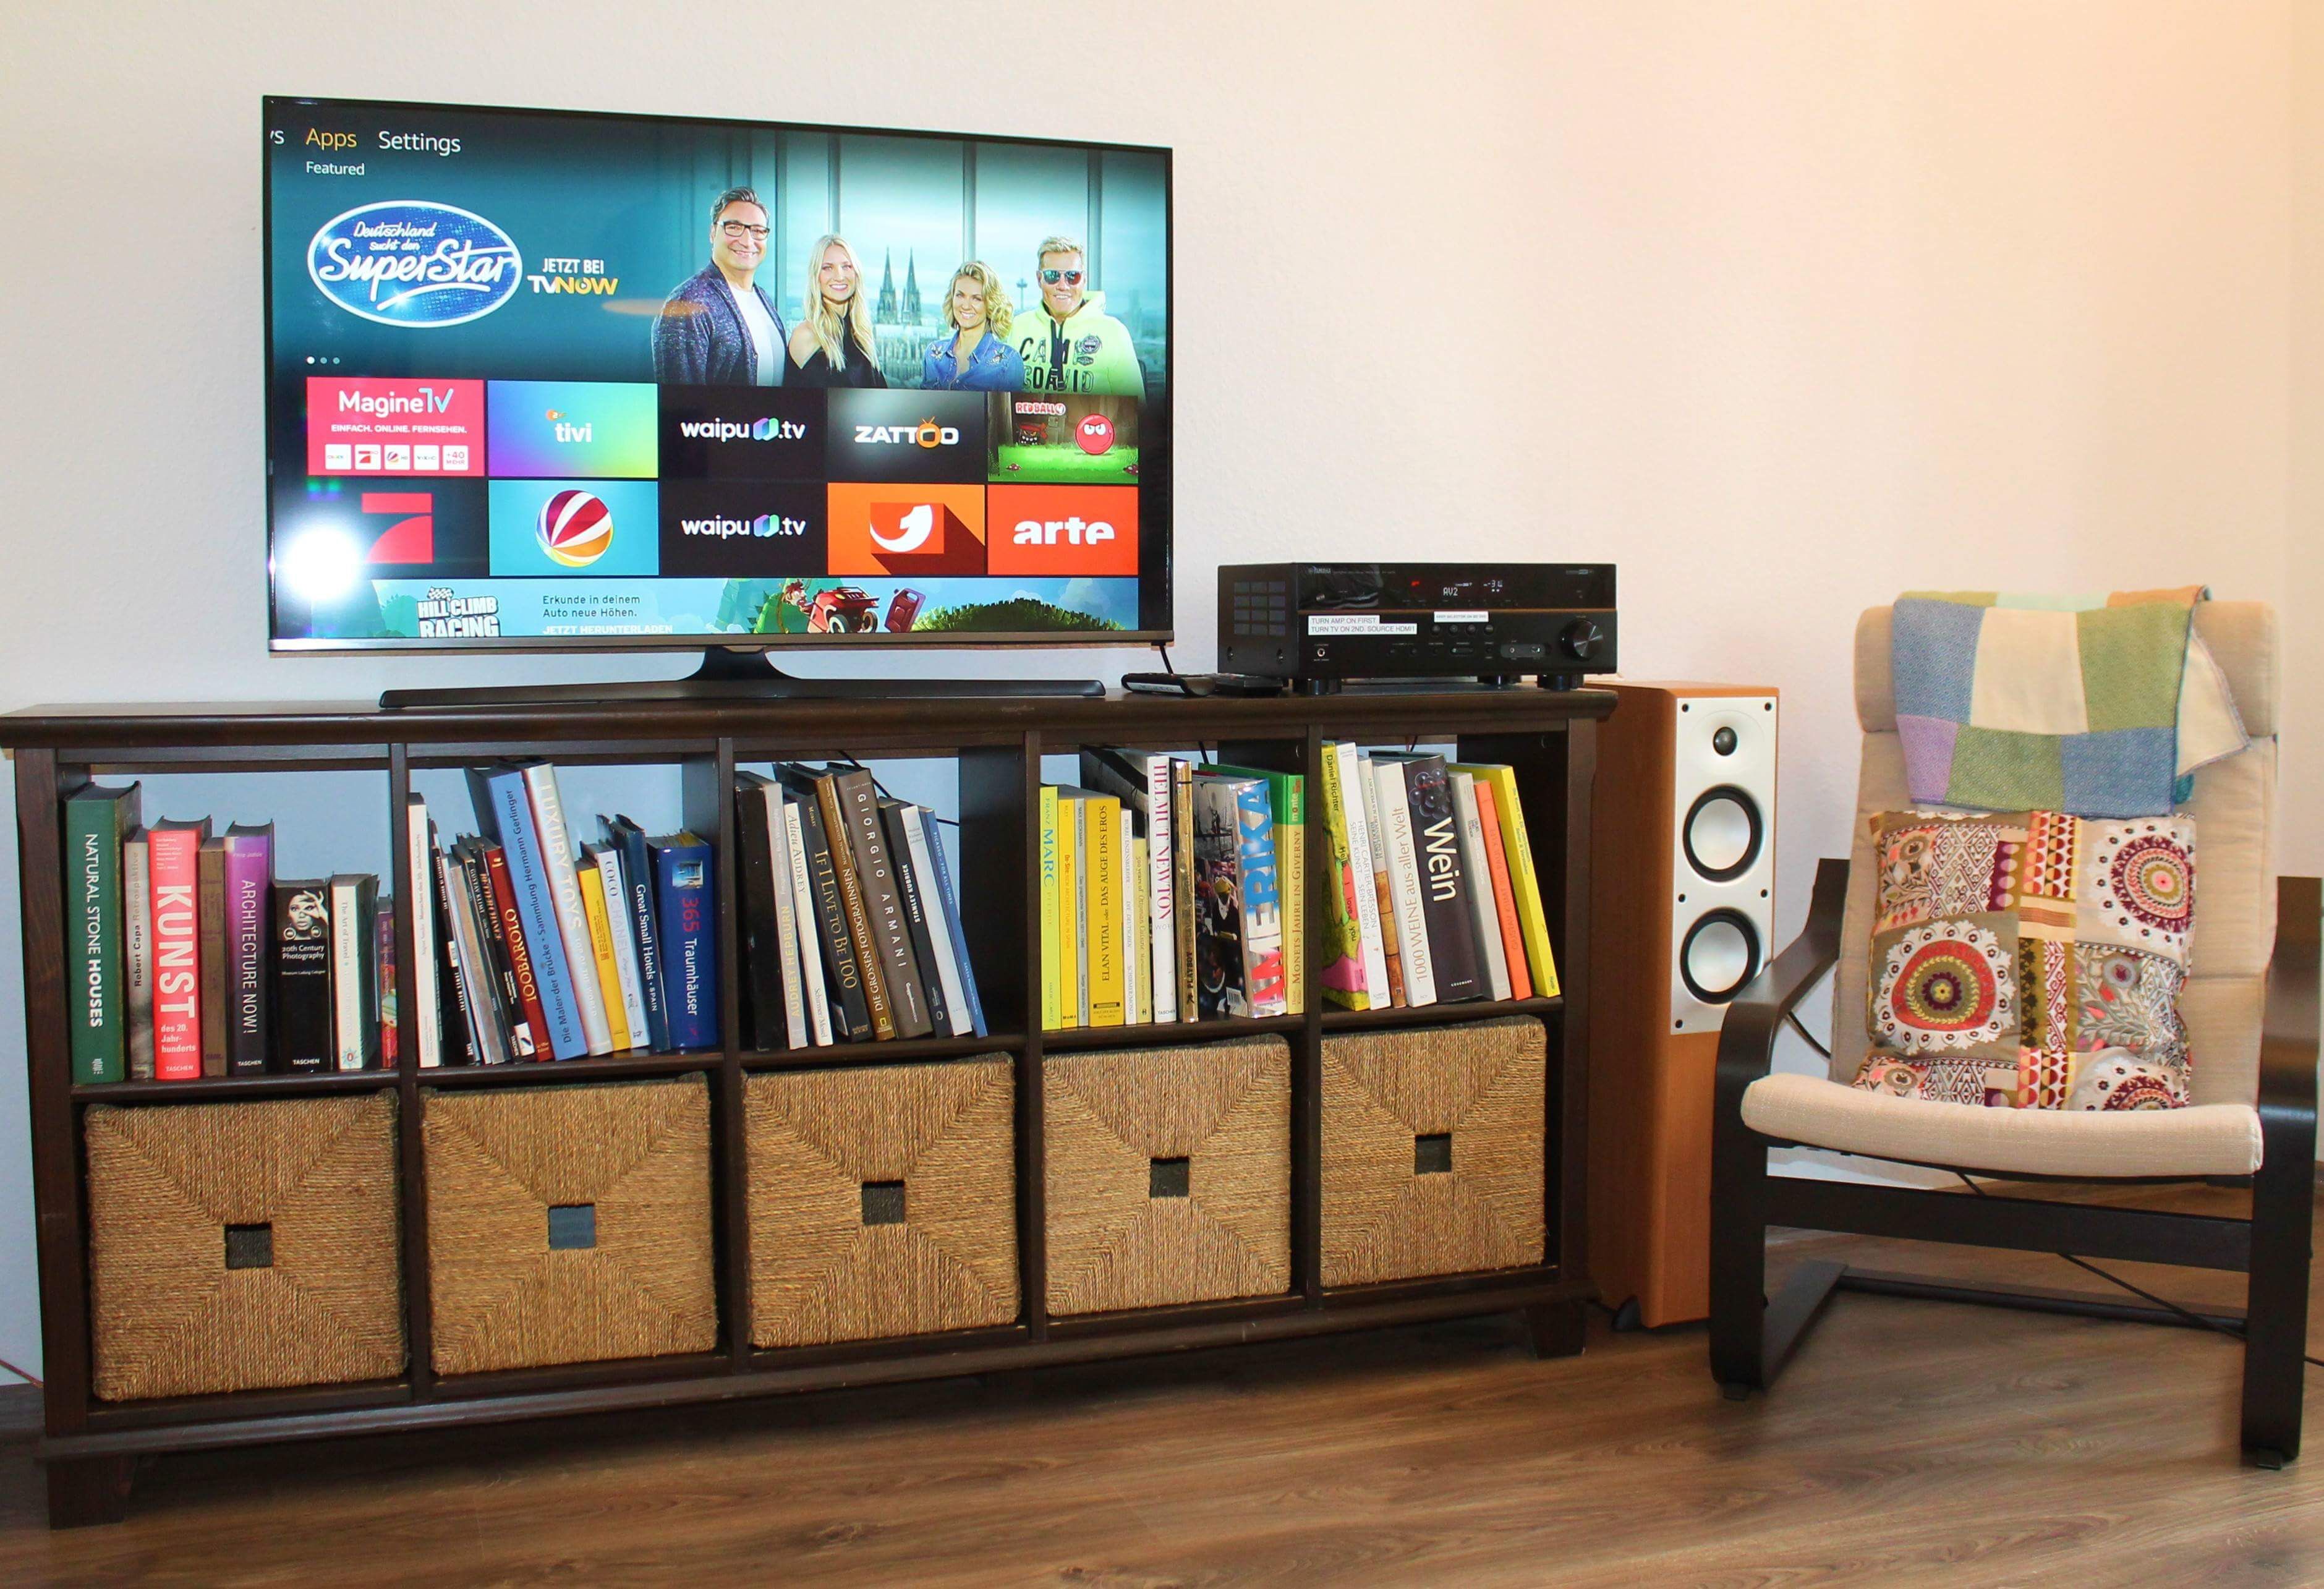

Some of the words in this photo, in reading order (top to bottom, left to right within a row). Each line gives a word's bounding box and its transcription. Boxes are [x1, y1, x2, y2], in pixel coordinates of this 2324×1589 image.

[305, 128, 357, 151] Apps
[378, 130, 461, 156] Settings
[306, 161, 365, 176] Featured
[354, 221, 438, 237] Deutschland
[369, 241, 399, 251] sucht
[401, 241, 420, 250] den
[319, 239, 517, 302] SuperStar
[542, 258, 580, 273] JETZT
[584, 260, 604, 275] BEI
[331, 424, 373, 433] EINFACH.
[374, 425, 411, 433] ONLINE.
[412, 425, 467, 433] FERNSEHEN.
[555, 422, 592, 443] tivi
[854, 423, 960, 448] ZATTOO
[1013, 517, 1115, 545] arte
[542, 595, 586, 605] Erkunde
[589, 595, 600, 604] in
[602, 595, 641, 605] deinem
[1443, 587, 1458, 596] AV2
[416, 600, 449, 619] HILL
[450, 595, 499, 617] CLIMB
[542, 608, 569, 618] Auto
[600, 607, 638, 617] Höhen.
[419, 616, 500, 637] RACING
[542, 626, 577, 635] JETZT
[580, 625, 673, 634] HERUNTERLADEN
[1325, 754, 1336, 780] Daniel
[1151, 764, 1170, 840] HELMUT
[1329, 782, 1341, 812] Richter
[506, 789, 521, 835] Gerlinger
[1098, 805, 1107, 832] EROS
[1390, 806, 1407, 839] Welt
[788, 814, 801, 845] Adieu
[1099, 834, 1107, 854] DES
[1349, 821, 1359, 845] SEINE
[85, 833, 100, 903] NATURAL
[515, 837, 534, 882] Hermann
[540, 784, 570, 869] LUXURY
[560, 875, 582, 931] TOYS
[931, 831, 943, 856] PICASSO
[939, 863, 947, 875] FOR
[945, 887, 954, 905] TIMES
[1042, 829, 1055, 887] MARC
[1099, 855, 1108, 884] AUGE
[1352, 846, 1363, 874] KUNST
[1395, 840, 1412, 870] aller
[1423, 817, 1458, 902] Wein
[603, 860, 619, 897] COCO
[818, 868, 833, 877] I
[858, 793, 884, 879] GIORGIO
[881, 893, 907, 967] ARMANI
[900, 863, 914, 893] KUBRICK
[1154, 845, 1173, 920] NEWTON
[1357, 820, 1367, 848] HENRI
[1362, 850, 1377, 928] CARTIER-BRESSON
[1402, 871, 1416, 895] aus
[469, 868, 480, 893] GUSTAV
[475, 893, 485, 914] KLIMT
[633, 883, 649, 913] Great
[1100, 886, 1108, 906] DAS
[1237, 779, 1287, 1003] AMERIKA
[1293, 884, 1301, 896] IN
[1357, 884, 1367, 902] SEIN
[529, 884, 547, 935] Sammlung
[681, 897, 700, 932] 365
[842, 868, 869, 948] FOTOGRAFINNEN
[908, 893, 921, 923] STANLEY
[1136, 894, 1144, 924] Ottoman
[1345, 897, 1355, 914] love
[1360, 905, 1371, 930] LEBEN
[87, 906, 101, 955] STONE
[134, 925, 142, 948] Capa
[240, 880, 257, 989] ARCHITECTURE
[609, 900, 629, 957] CHANEL
[637, 914, 652, 944] Small
[783, 905, 796, 966] HEPBURN
[1348, 926, 1358, 942] you
[1406, 898, 1423, 947] WEINE
[156, 885, 195, 1019] KUNST
[282, 952, 325, 961] Photography
[299, 945, 325, 953] Century
[541, 944, 556, 976] Brücke
[641, 946, 657, 980] Hotels
[134, 950, 142, 987] Robert
[683, 938, 700, 1015] Traumhäuser
[861, 950, 879, 994] GROSSEN
[1101, 954, 1110, 981] ELAN
[1411, 948, 1428, 982] 1000
[88, 959, 103, 1028] HOUSES
[548, 978, 560, 995] der
[648, 986, 657, 1011] SPAIN
[789, 969, 801, 1017] AUDREY
[242, 993, 258, 1034] NOW!
[553, 996, 568, 1025] Maler
[871, 994, 883, 1012] DIE
[161, 1025, 175, 1033] des
[176, 1023, 189, 1031] 20.
[161, 1035, 182, 1043] Jahr-
[560, 1027, 572, 1044] Die
[161, 1044, 197, 1054] hunderts
[237, 1059, 263, 1067] TASCHEN
